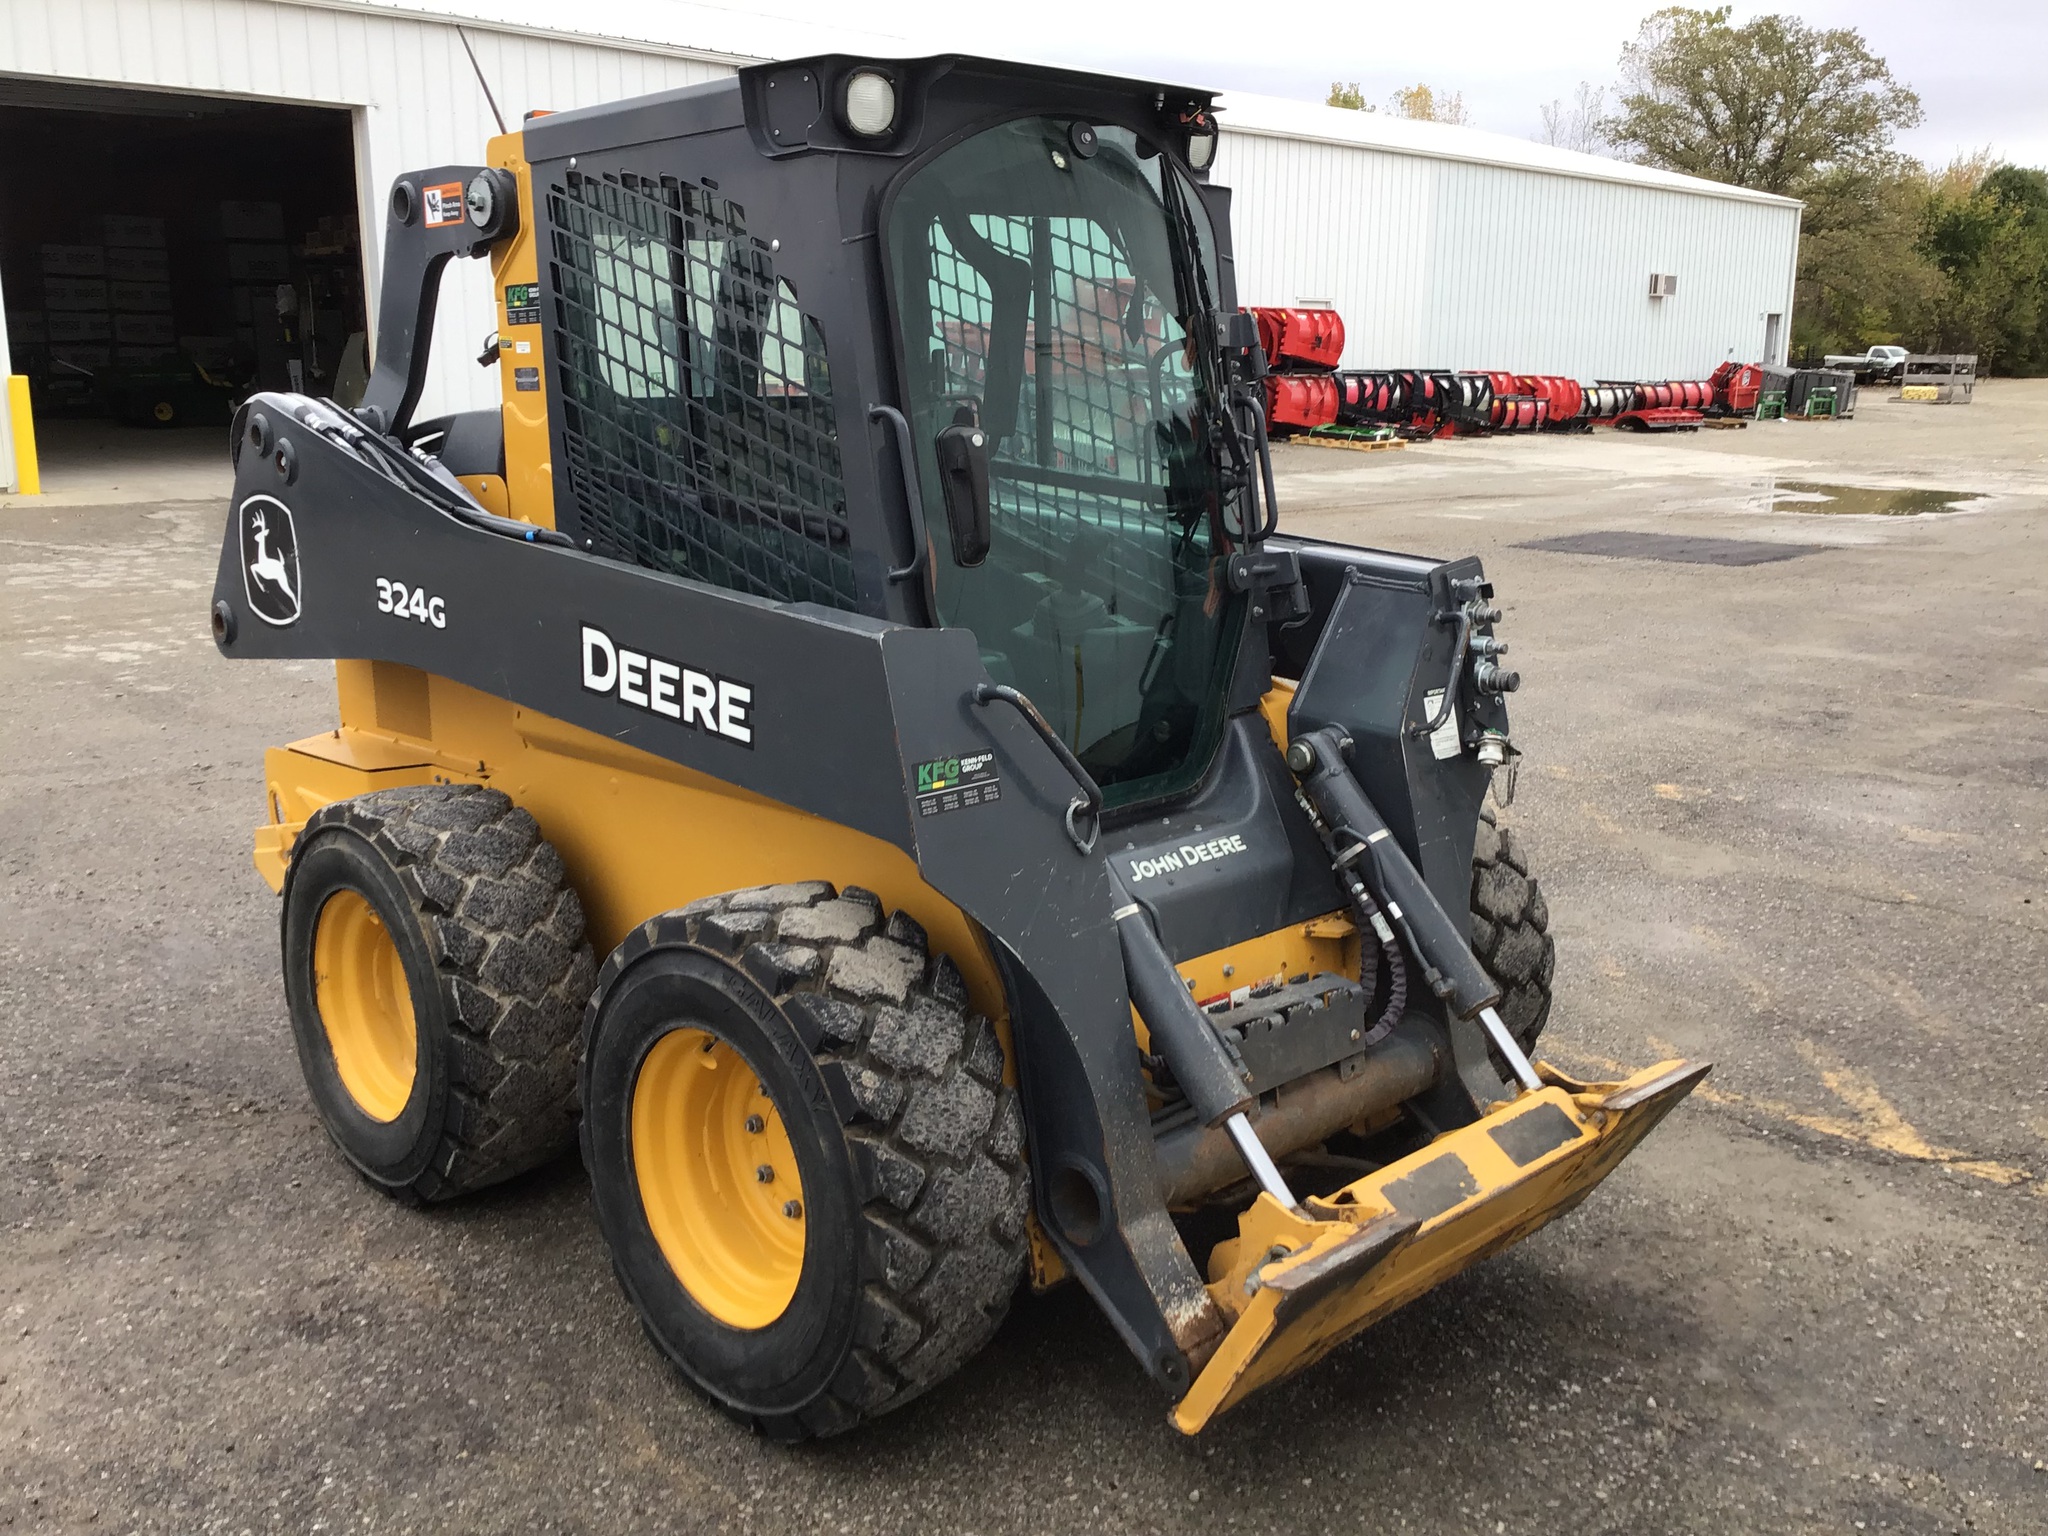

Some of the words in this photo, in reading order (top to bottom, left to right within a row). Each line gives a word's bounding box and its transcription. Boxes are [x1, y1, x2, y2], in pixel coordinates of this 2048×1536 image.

[507, 287, 528, 302] KFG
[376, 577, 446, 629] 324G
[582, 626, 751, 744] DEERE
[918, 758, 960, 785] KFG
[961, 762, 984, 773] GROUP
[1130, 852, 1184, 882] JOHN
[1179, 834, 1248, 866] DEERE
